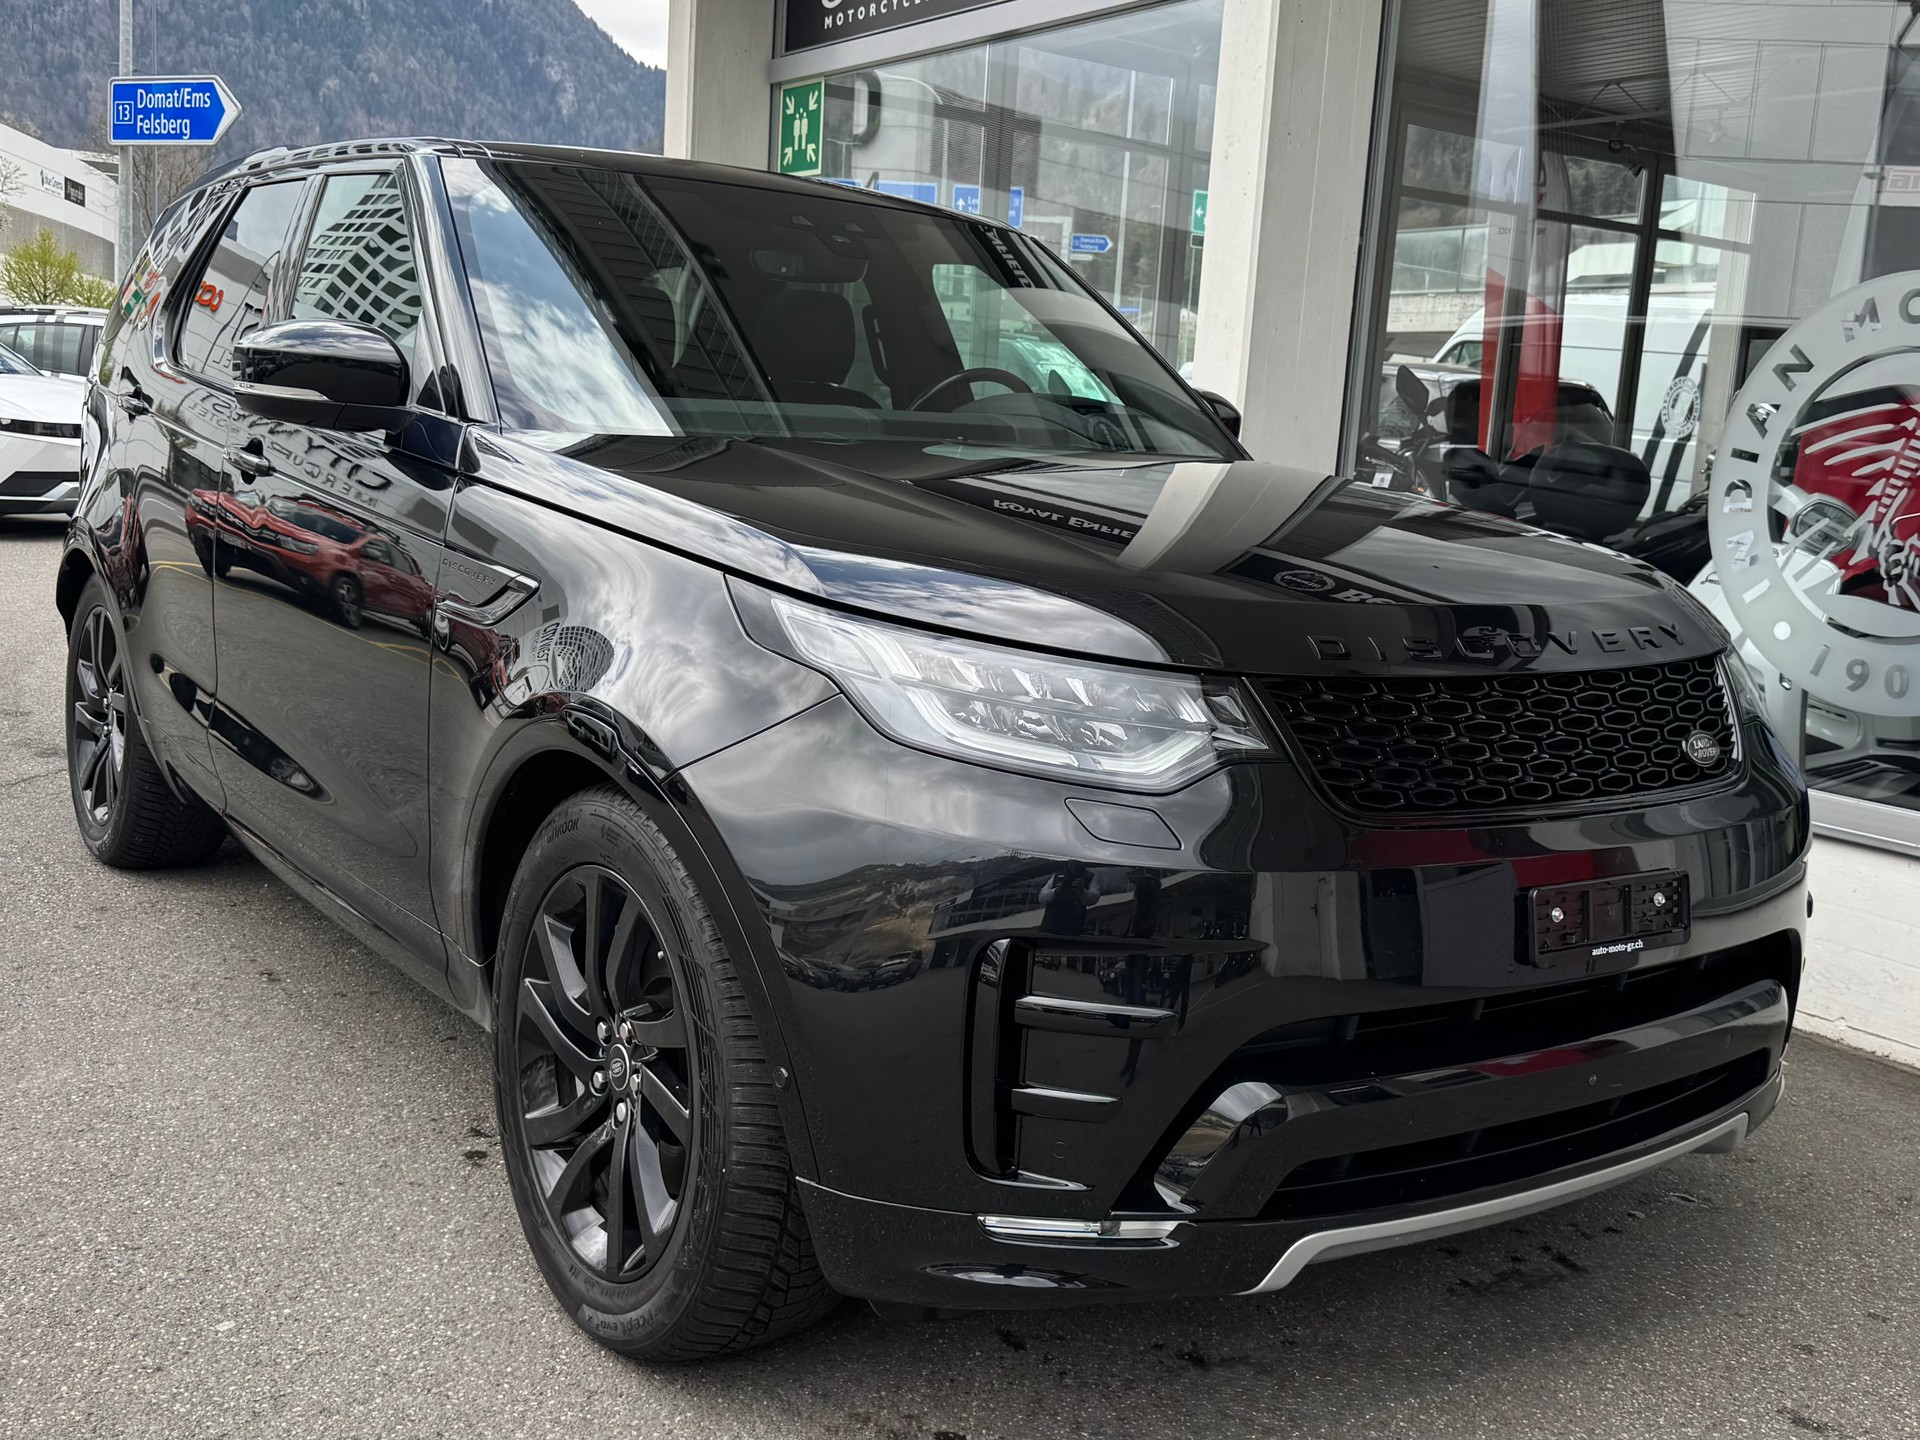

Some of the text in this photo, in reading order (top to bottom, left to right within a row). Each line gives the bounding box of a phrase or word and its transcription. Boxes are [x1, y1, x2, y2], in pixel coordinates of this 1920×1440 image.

[824, 0, 931, 29] MOTORCYC
[118, 104, 131, 121] 13
[136, 87, 211, 109] Domat/Ems
[136, 113, 191, 140] Felsberg
[1722, 287, 1920, 605] INDIAN MO
[442, 557, 496, 587] DISCOVERY
[1307, 623, 1685, 661] DISCOVERY
[1809, 643, 1910, 700] 190
[1591, 938, 1644, 956] auto-moto-gr.ch
